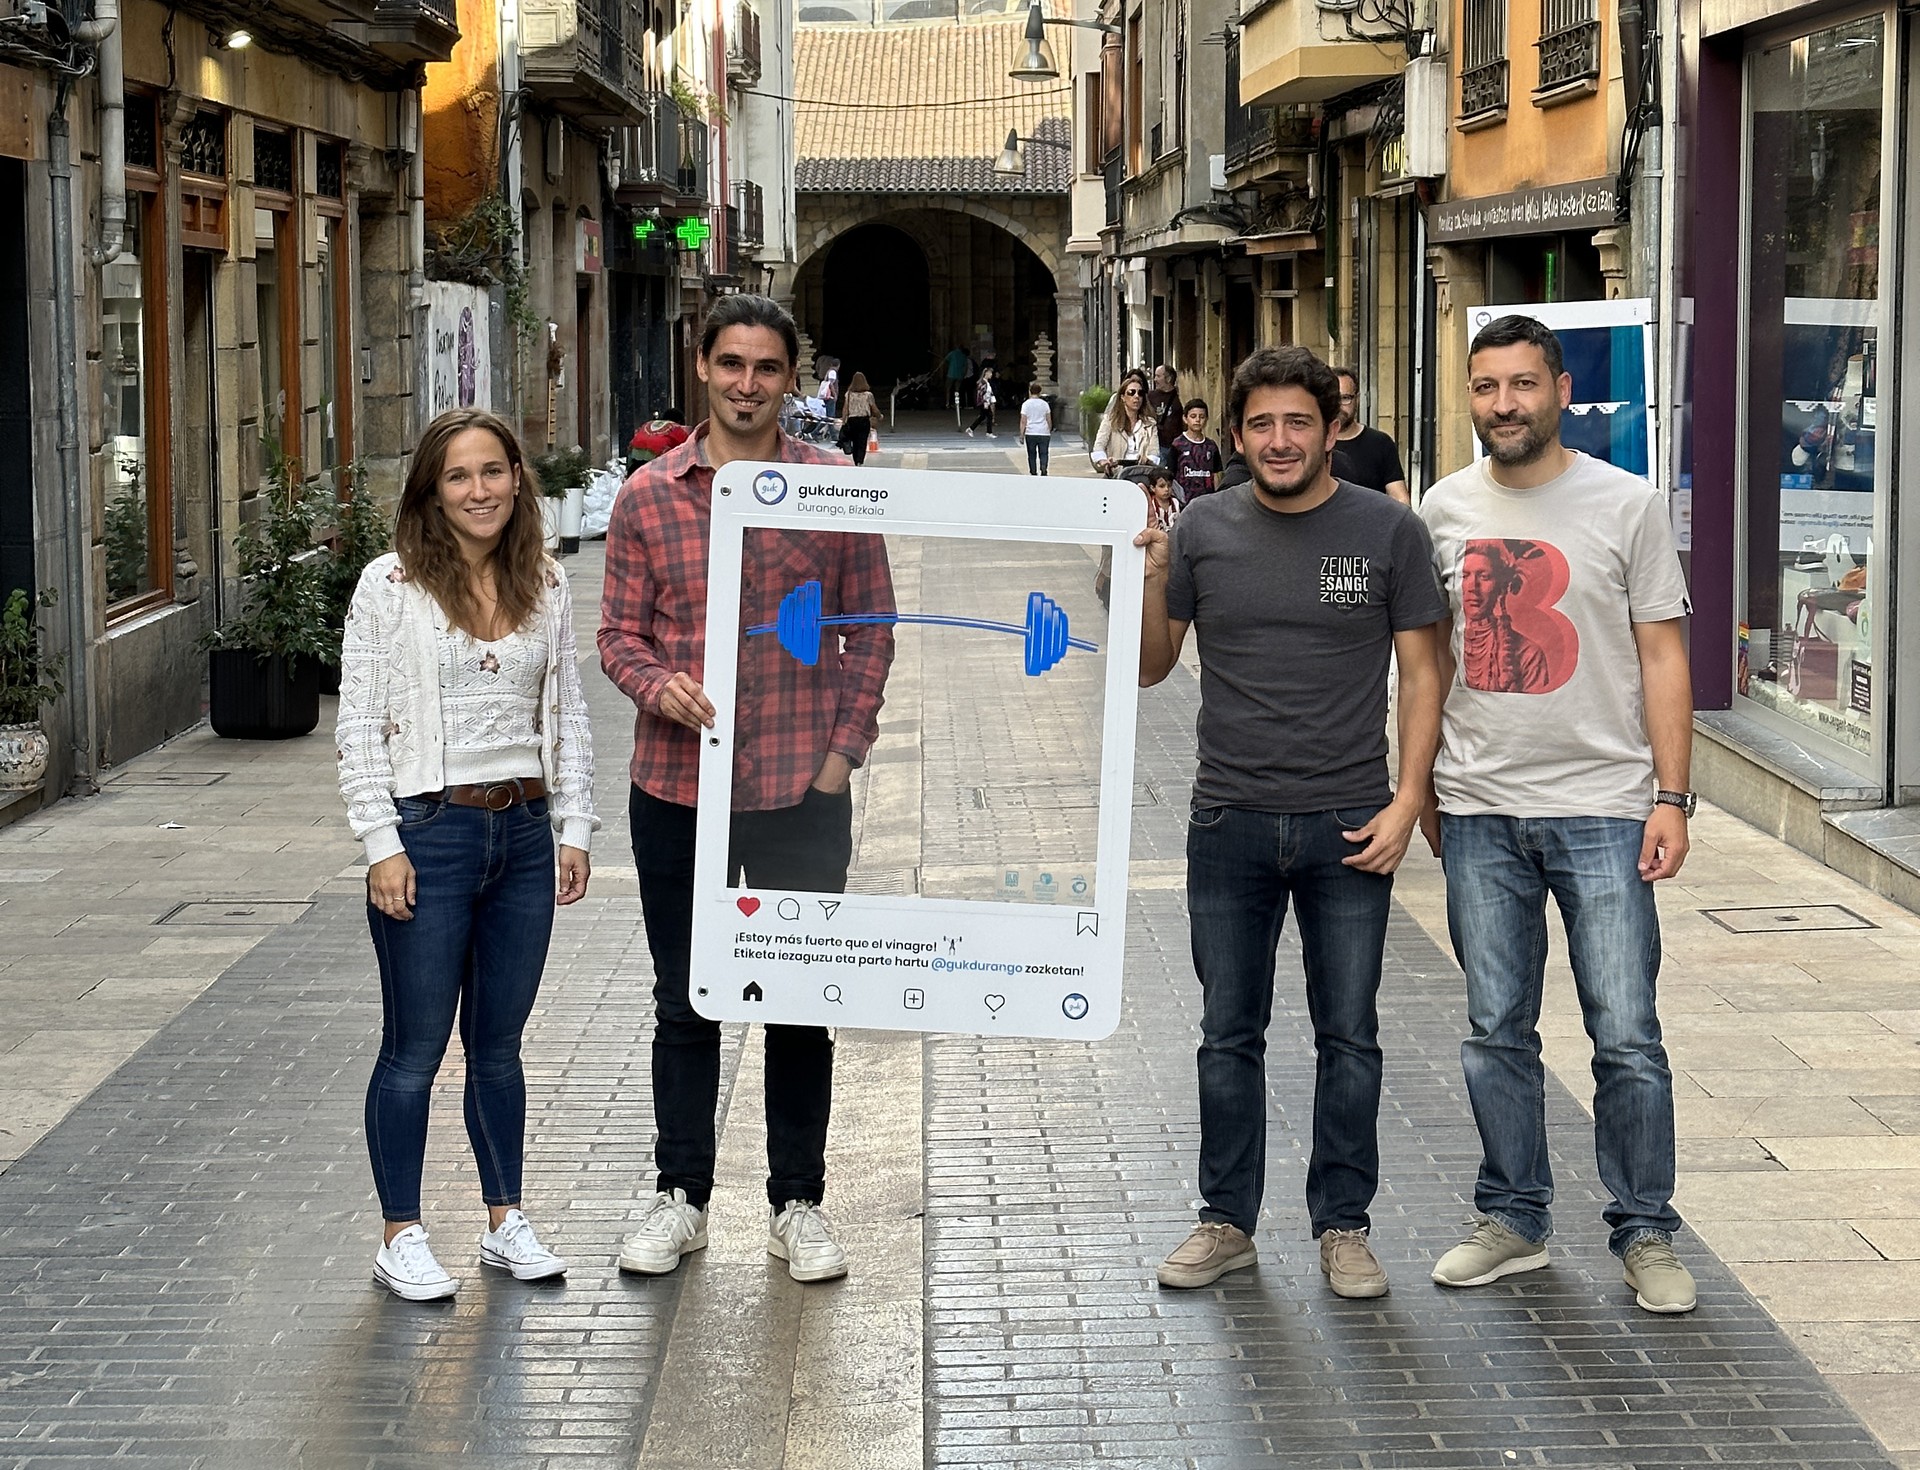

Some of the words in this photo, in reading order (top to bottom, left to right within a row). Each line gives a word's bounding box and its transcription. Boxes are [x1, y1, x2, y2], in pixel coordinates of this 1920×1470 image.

[1587, 193, 1597, 213] ez
[761, 483, 778, 494] guk
[798, 484, 889, 502] gukdurango
[797, 502, 846, 516] Durango,
[848, 504, 885, 516] Bizkaia
[1320, 556, 1370, 576] ZEINEK
[1320, 591, 1369, 604] ZIGUN
[735, 932, 772, 946] ¡Estoy
[775, 933, 802, 945] más
[805, 934, 842, 947] fuerte
[845, 938, 869, 950] que
[871, 938, 883, 949] el
[885, 938, 937, 954] vinagre!
[734, 948, 776, 960] Etiketa
[778, 949, 833, 964] iezaguzu
[835, 953, 856, 964] eta
[858, 954, 892, 968] parte
[894, 955, 929, 968] hartu
[931, 957, 1023, 975] @gukdurango
[1025, 963, 1085, 977] zozketan!
